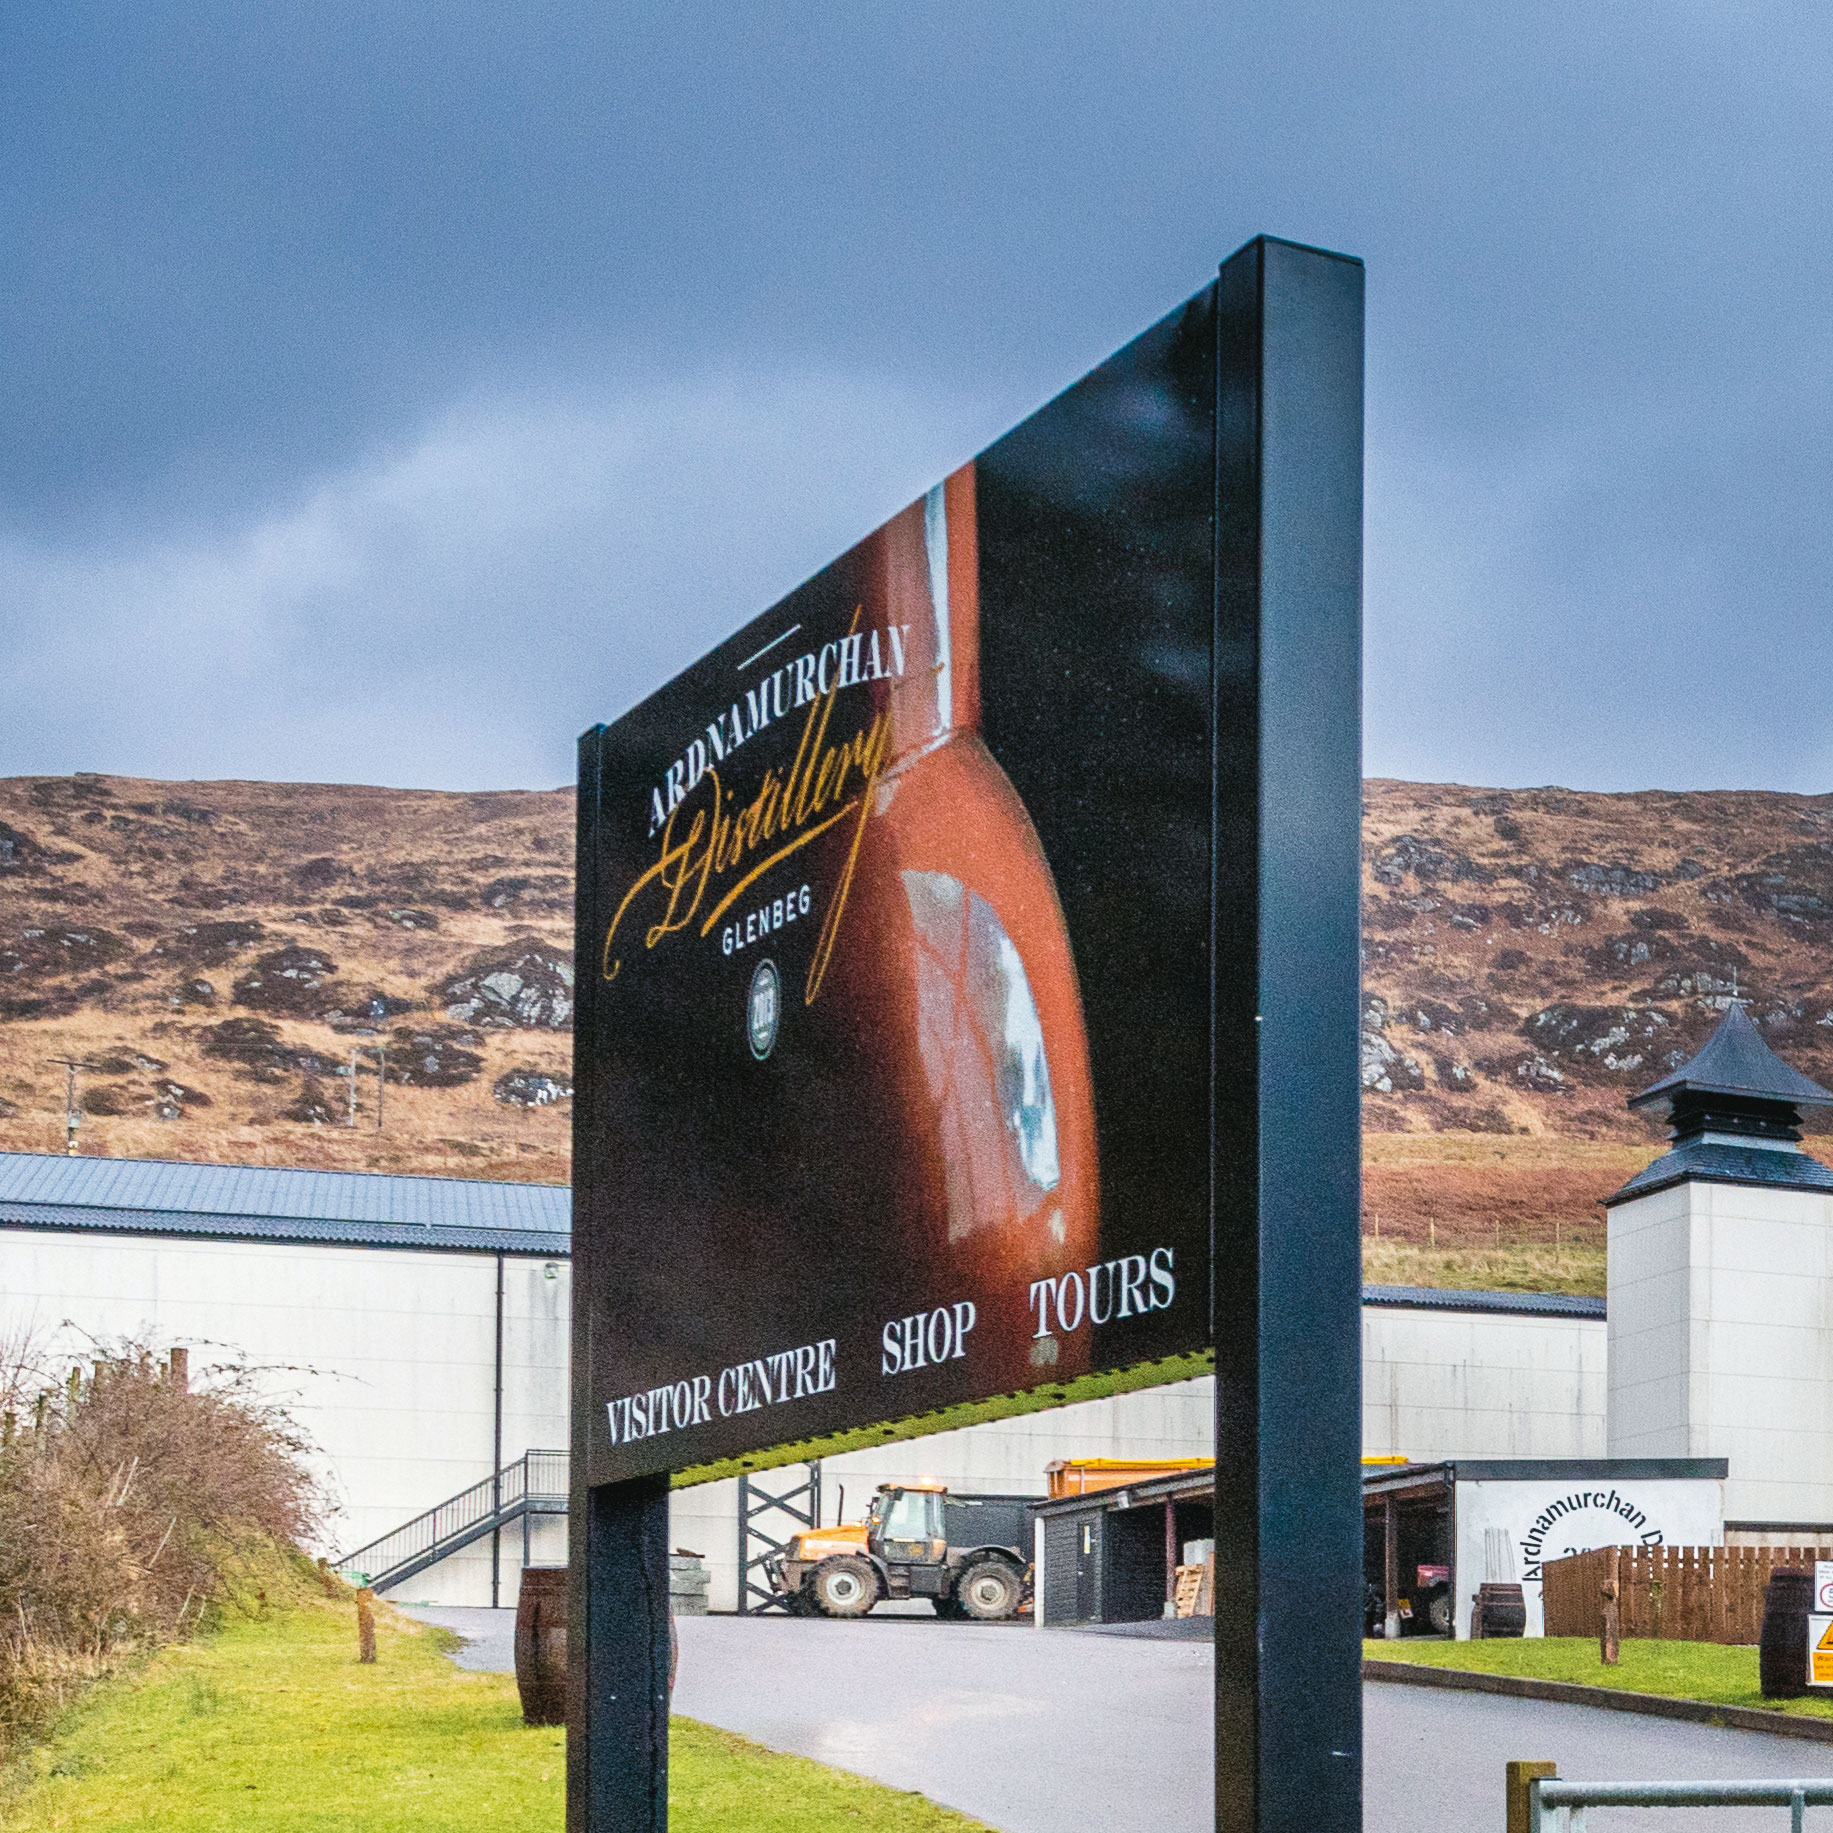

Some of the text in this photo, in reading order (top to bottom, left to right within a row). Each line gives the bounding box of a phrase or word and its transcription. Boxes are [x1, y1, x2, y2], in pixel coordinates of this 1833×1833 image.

[648, 623, 911, 839] ARDNAMURCHAN
[603, 604, 893, 1005] Distillery
[722, 884, 811, 956] GLENBEG
[881, 1301, 976, 1376] SHOP
[1029, 1247, 1175, 1339] TOURS
[606, 1338, 836, 1447] VISITOR CENTRE
[1519, 1489, 1647, 1582] Ardnamurchan
